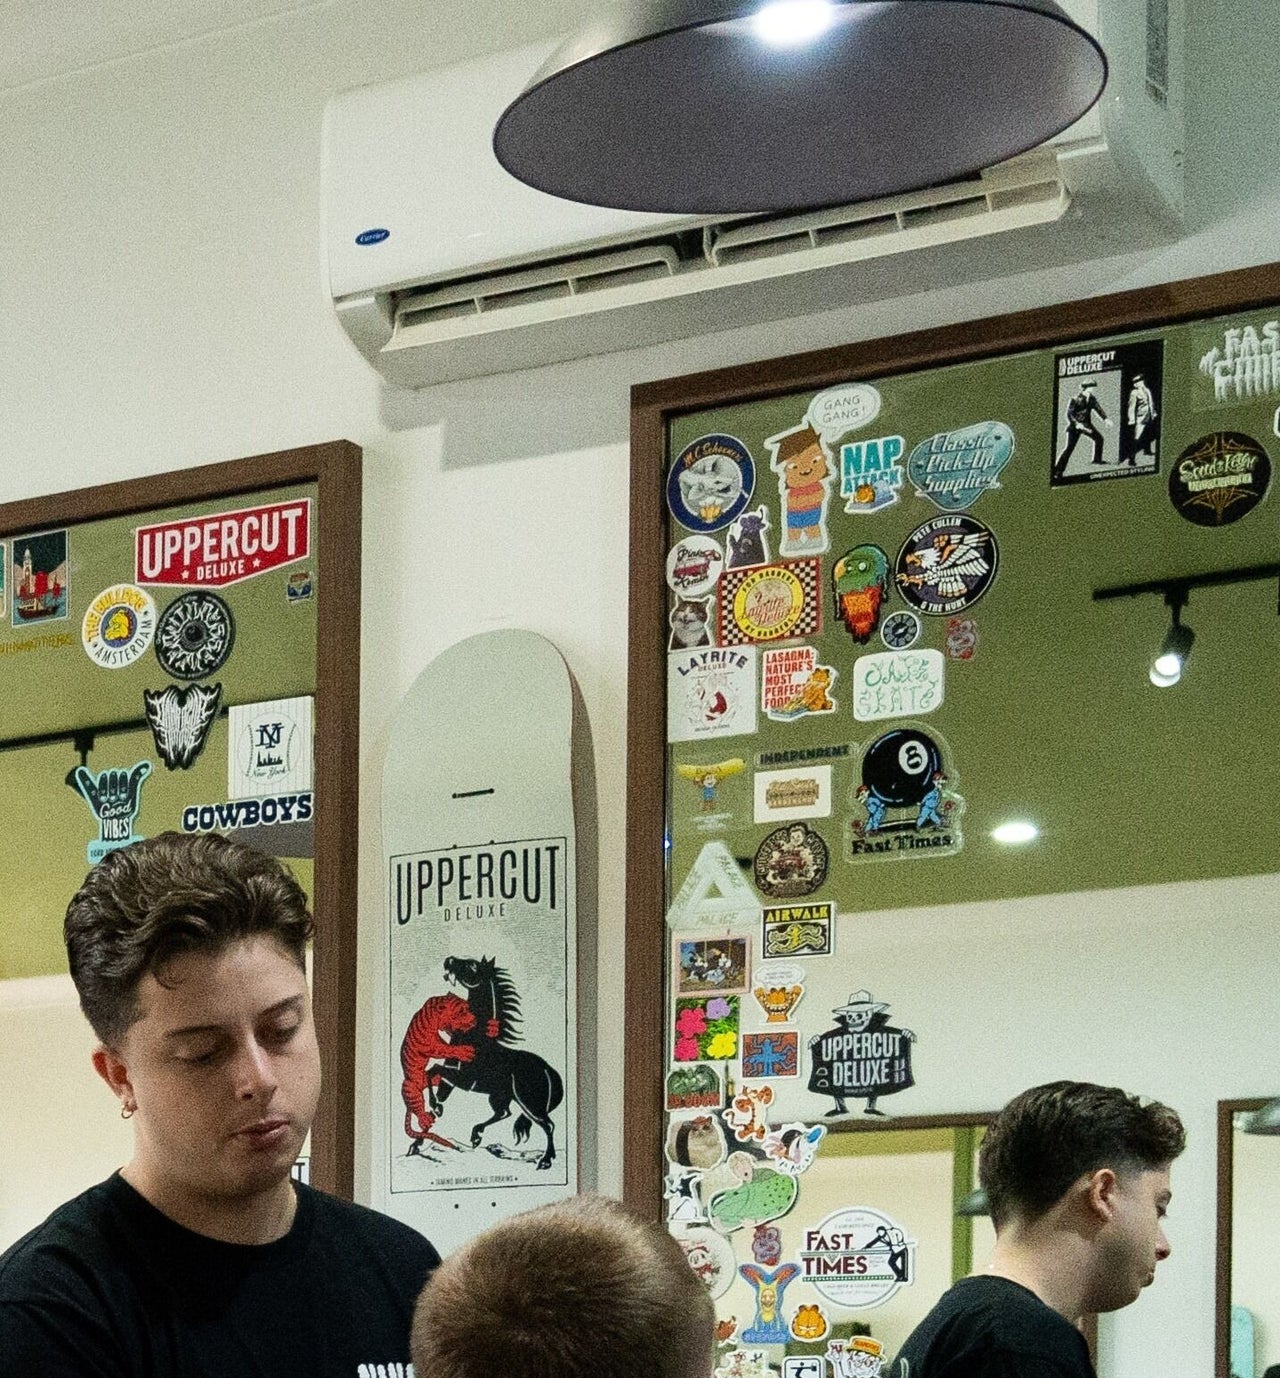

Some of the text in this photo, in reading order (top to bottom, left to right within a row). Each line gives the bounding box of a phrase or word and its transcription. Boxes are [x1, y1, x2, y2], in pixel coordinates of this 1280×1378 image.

[360, 230, 386, 243] Carrier
[1225, 321, 1280, 358] FAS
[1067, 351, 1116, 368] UPPERCUT
[1067, 361, 1103, 375] DELUXE
[824, 395, 860, 411] GANG
[844, 438, 901, 477] NAP
[912, 518, 962, 543] PETE CULLEN
[143, 508, 302, 578] UPPERCUT
[197, 560, 245, 580] DELUXE
[742, 579, 755, 593] FOR
[86, 608, 100, 642] THE
[95, 619, 153, 664] AMSTERDAM
[677, 650, 748, 676] LAYRITE
[765, 660, 813, 675] NATURE'S
[766, 650, 814, 664] LASAGNA:
[765, 674, 791, 685] MOST
[905, 745, 923, 769] 8
[100, 801, 131, 818] Good
[183, 795, 312, 831] COWBOYS
[103, 818, 129, 839] VIBES
[851, 834, 952, 855] Fast Times
[396, 845, 560, 926] UPPERCUT
[444, 902, 507, 923] DELUXE
[766, 905, 828, 923] AIRWALK
[822, 1032, 902, 1062] UPPERCUT
[833, 1060, 890, 1087] DELUXE
[807, 1230, 854, 1251] FAST
[802, 1256, 868, 1276] TIMES
